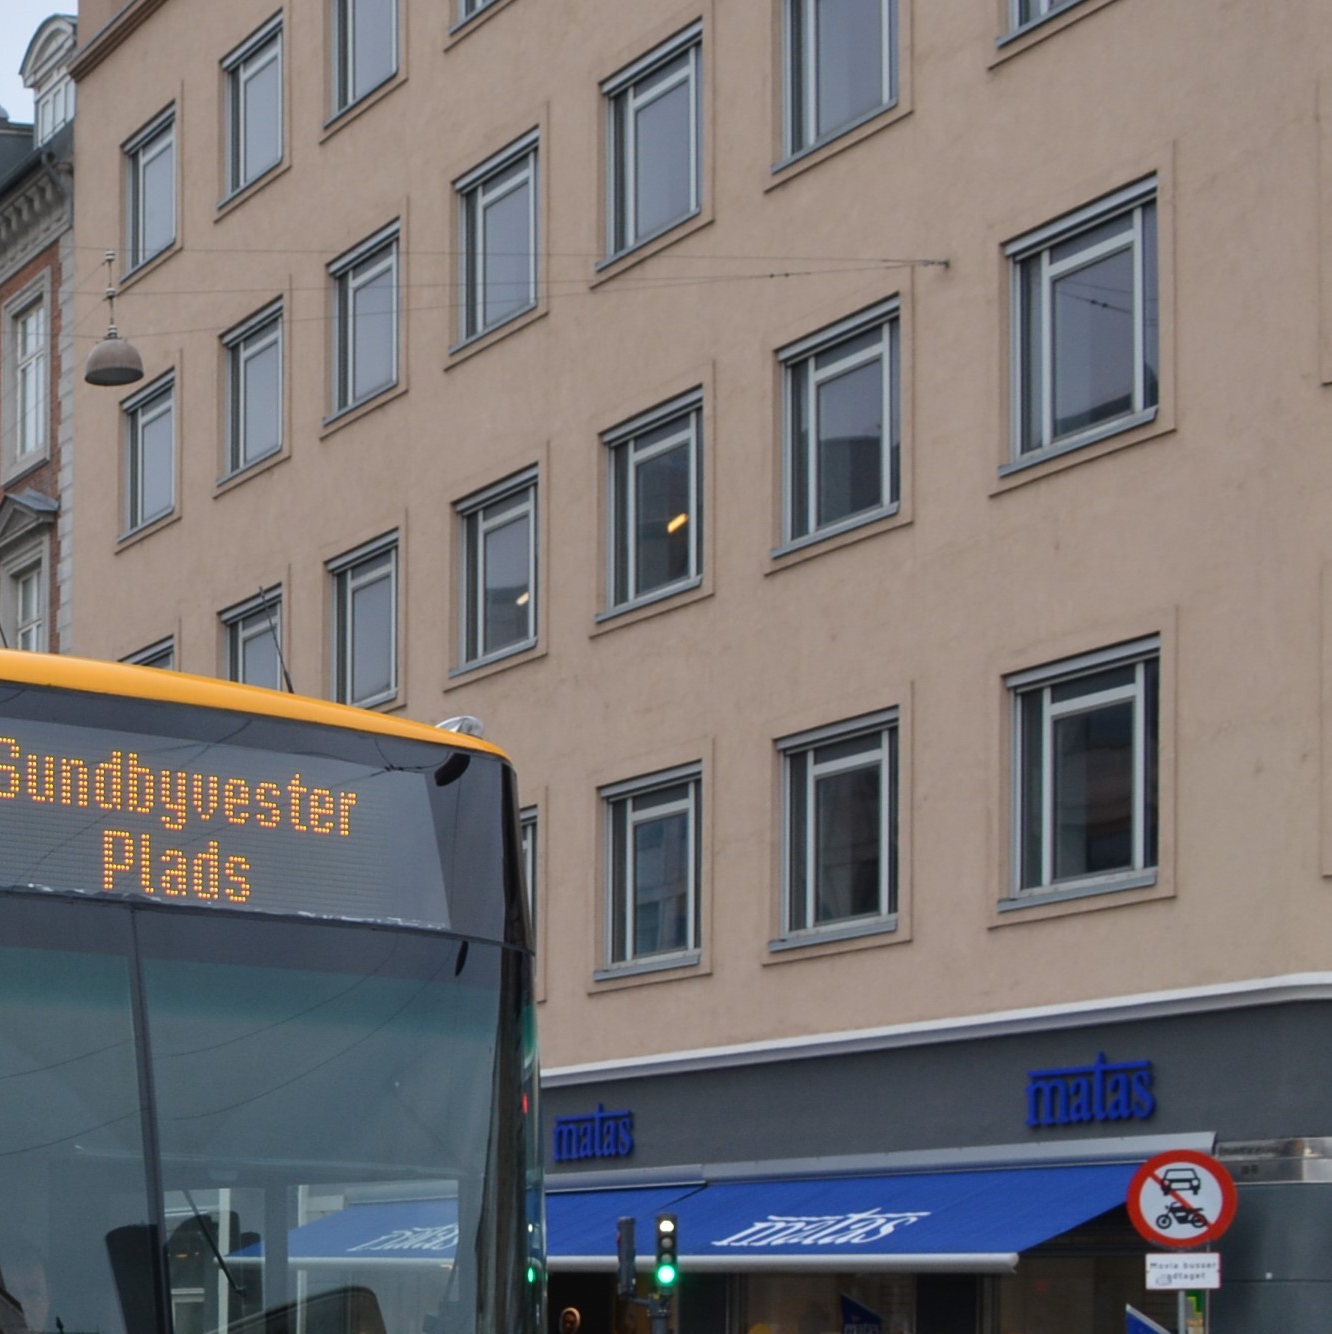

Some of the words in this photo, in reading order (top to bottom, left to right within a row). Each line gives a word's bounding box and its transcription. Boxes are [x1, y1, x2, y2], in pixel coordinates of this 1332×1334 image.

[102, 829, 251, 902] Plads
[1025, 1051, 1155, 1127] matas
[552, 1103, 634, 1162] matas
[710, 1207, 932, 1247] matas
